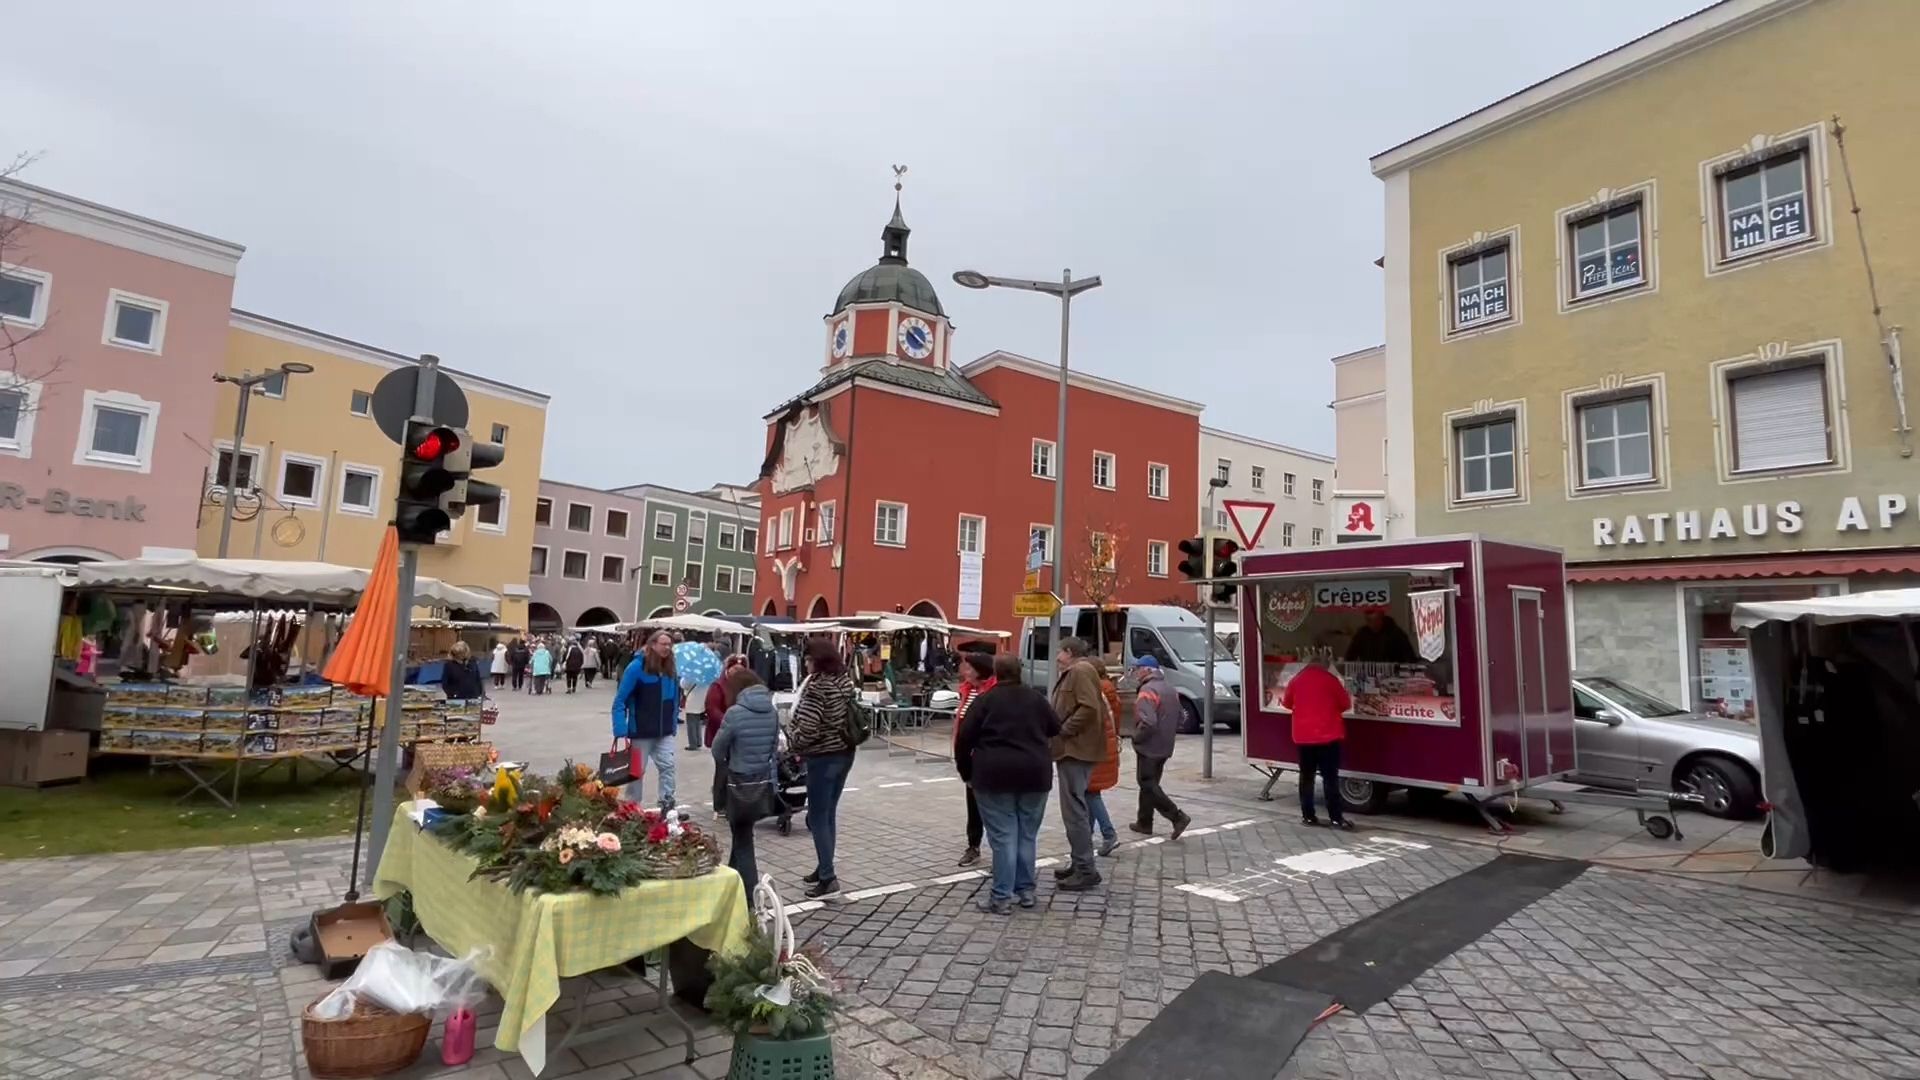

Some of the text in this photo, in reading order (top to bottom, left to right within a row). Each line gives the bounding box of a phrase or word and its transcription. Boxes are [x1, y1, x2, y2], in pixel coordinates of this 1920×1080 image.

[1733, 201, 1800, 232] NACH
[1734, 220, 1801, 249] HILFE
[1461, 286, 1504, 307] NACH
[1461, 300, 1505, 321] HILFE
[1592, 494, 1920, 545] RATHAUS AP
[1317, 587, 1387, 608] Crêpes
